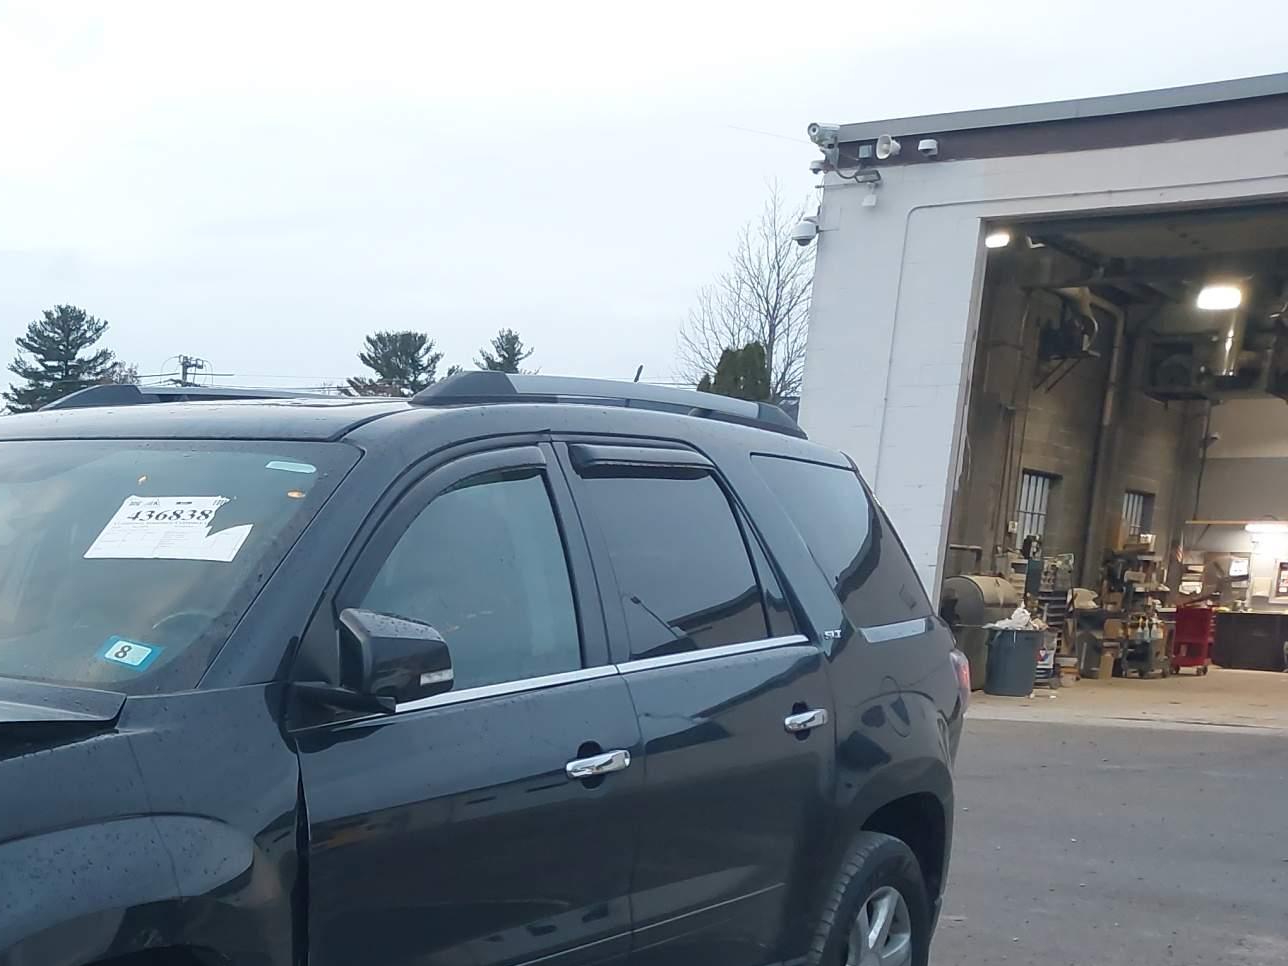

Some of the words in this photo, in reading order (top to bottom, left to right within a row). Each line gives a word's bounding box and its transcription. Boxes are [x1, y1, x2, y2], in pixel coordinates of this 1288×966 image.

[127, 509, 214, 522] 436838
[823, 629, 842, 640] SLT
[114, 645, 132, 659] 8
